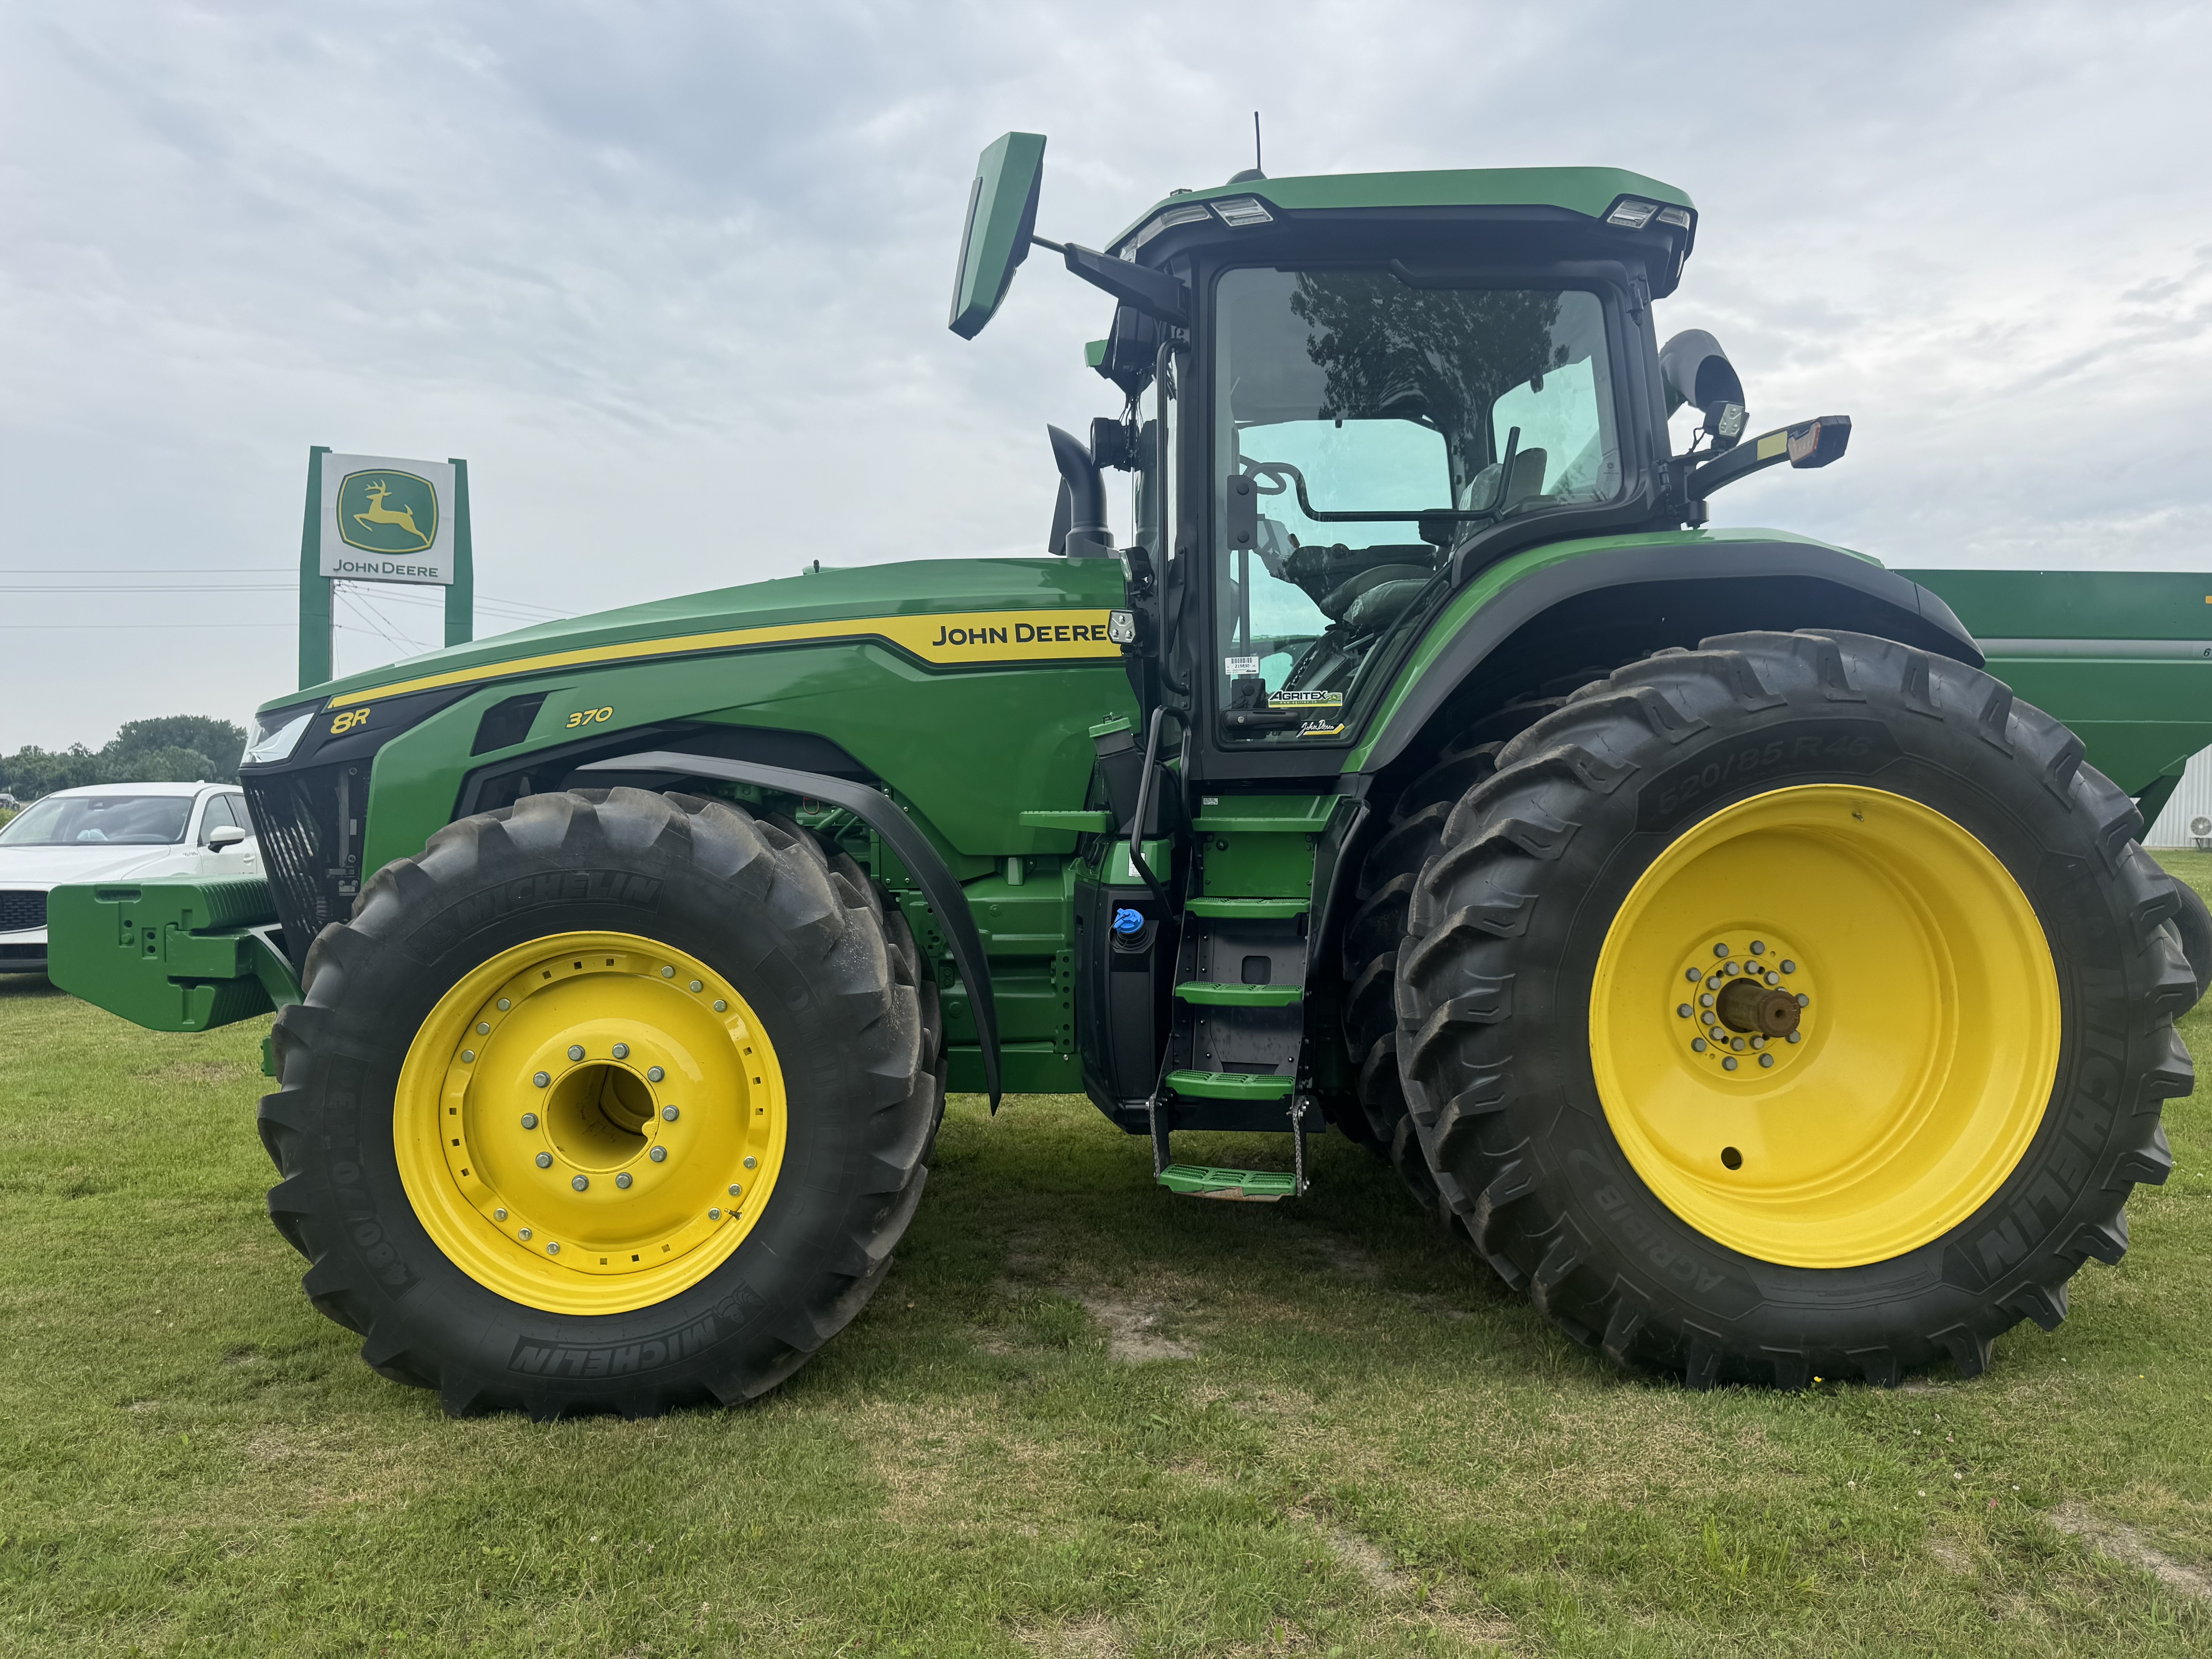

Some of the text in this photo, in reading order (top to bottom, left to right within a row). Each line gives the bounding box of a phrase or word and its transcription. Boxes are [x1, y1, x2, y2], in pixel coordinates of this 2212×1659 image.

[333, 559, 438, 577] JOHN DEERE
[932, 623, 1107, 646] JOHN DEERE
[2203, 648, 2212, 657] 6
[1269, 691, 1327, 700] AGRITEX
[330, 708, 371, 734] 8R
[565, 706, 613, 729] 370
[1659, 740, 1784, 814] 520/85
[457, 872, 662, 928] MICHELIN
[1976, 965, 2125, 1280] MICHELIN
[331, 1161, 409, 1286] 480/70
[1594, 1184, 1726, 1293] AGRIBIB
[510, 1316, 718, 1377] MICHELIN
